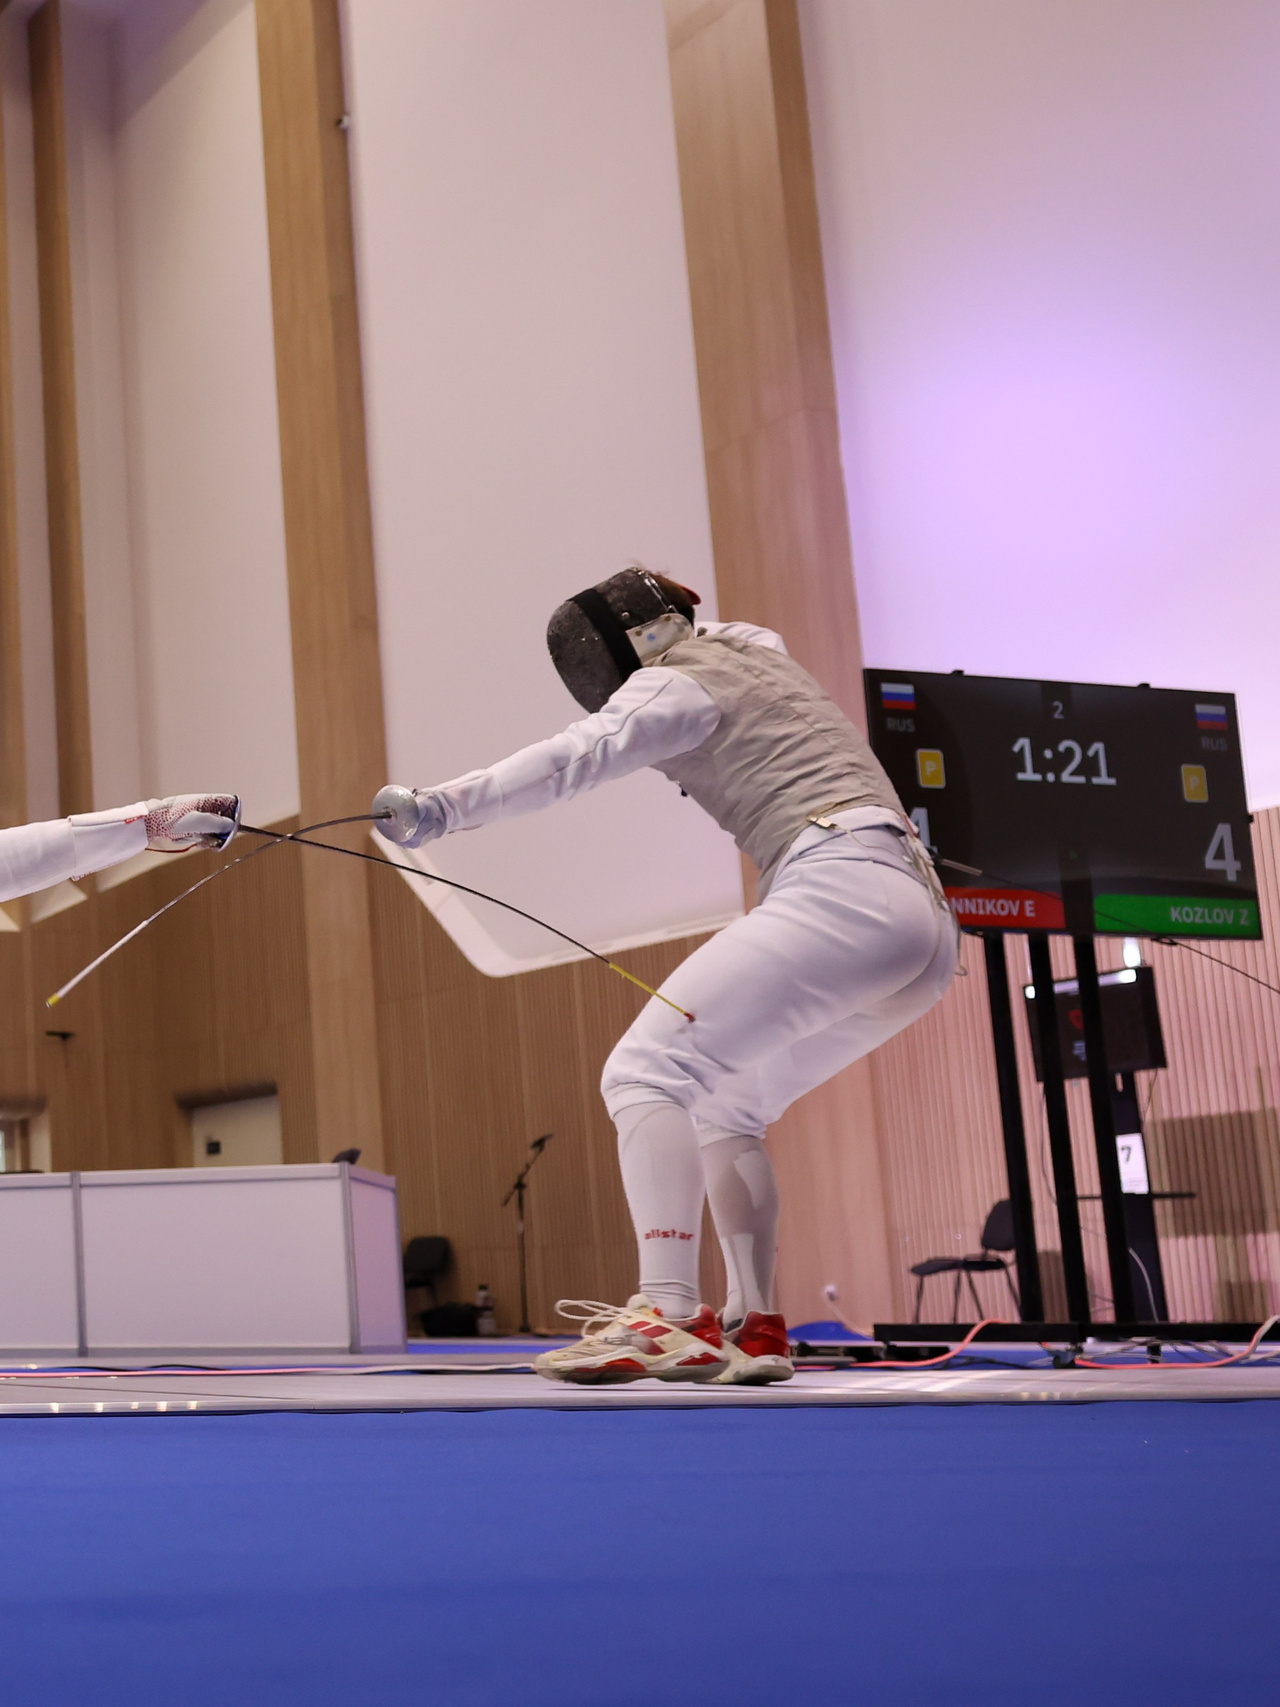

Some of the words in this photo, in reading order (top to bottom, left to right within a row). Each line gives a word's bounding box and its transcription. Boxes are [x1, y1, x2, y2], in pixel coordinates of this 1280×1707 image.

[1052, 701, 1065, 720] 2
[886, 717, 915, 732] RUS
[1201, 736, 1228, 751] RUS
[925, 761, 936, 775] P
[1011, 737, 1117, 786] 1:21
[1204, 823, 1242, 882] 4
[1024, 899, 1036, 917] E
[1170, 906, 1234, 925] KOZLOV
[1239, 909, 1250, 926] Z
[1121, 1147, 1132, 1162] 7
[645, 1229, 693, 1240] allstar
